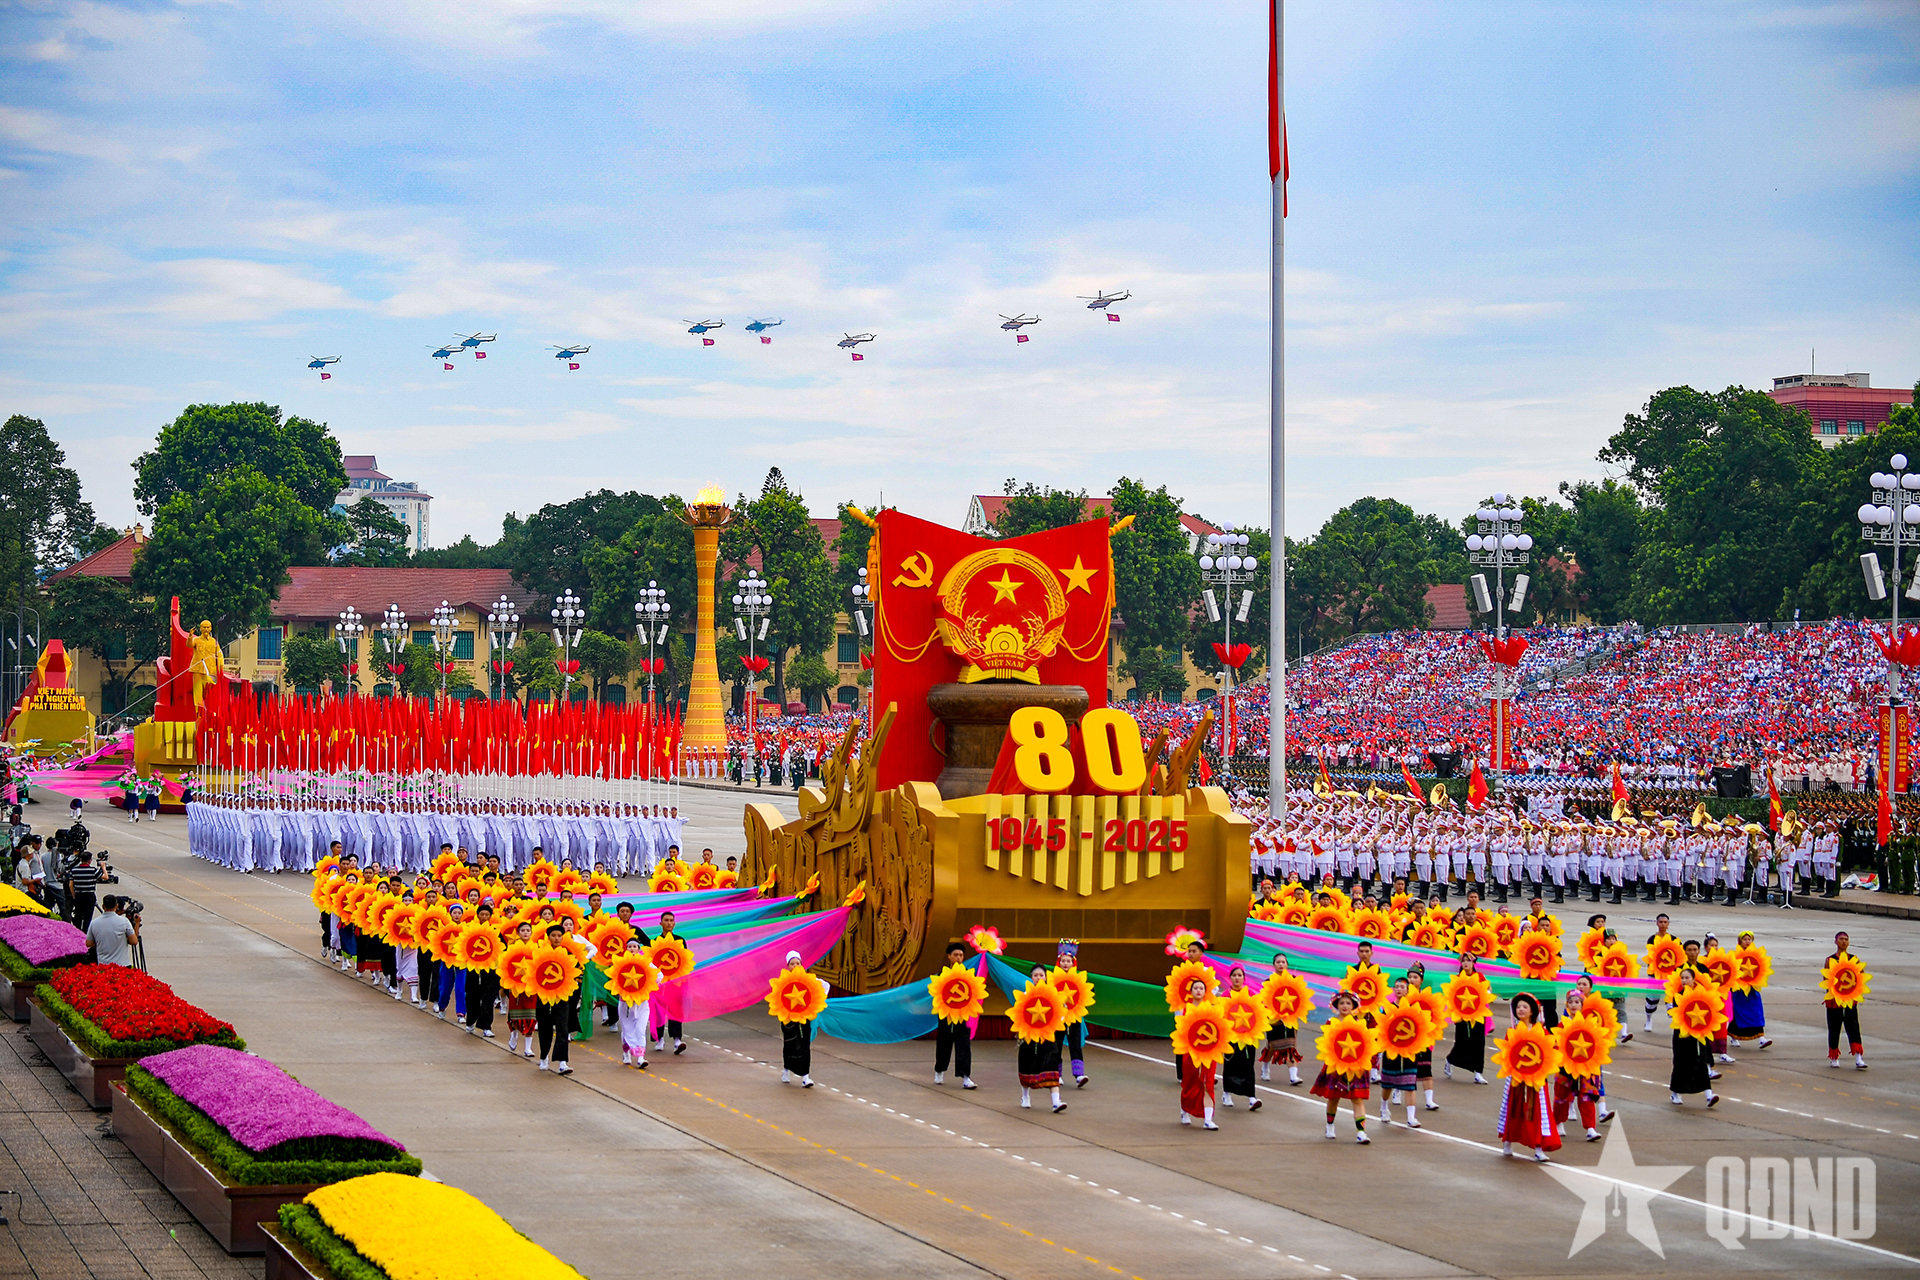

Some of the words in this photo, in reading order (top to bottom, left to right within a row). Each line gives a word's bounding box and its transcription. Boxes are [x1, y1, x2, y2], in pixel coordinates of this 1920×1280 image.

[985, 658, 1004, 668] VIỆT
[1005, 659, 1024, 669] NAM
[1010, 706, 1147, 792] 80
[986, 817, 1067, 851] 1945
[1104, 819, 1189, 853] 2025
